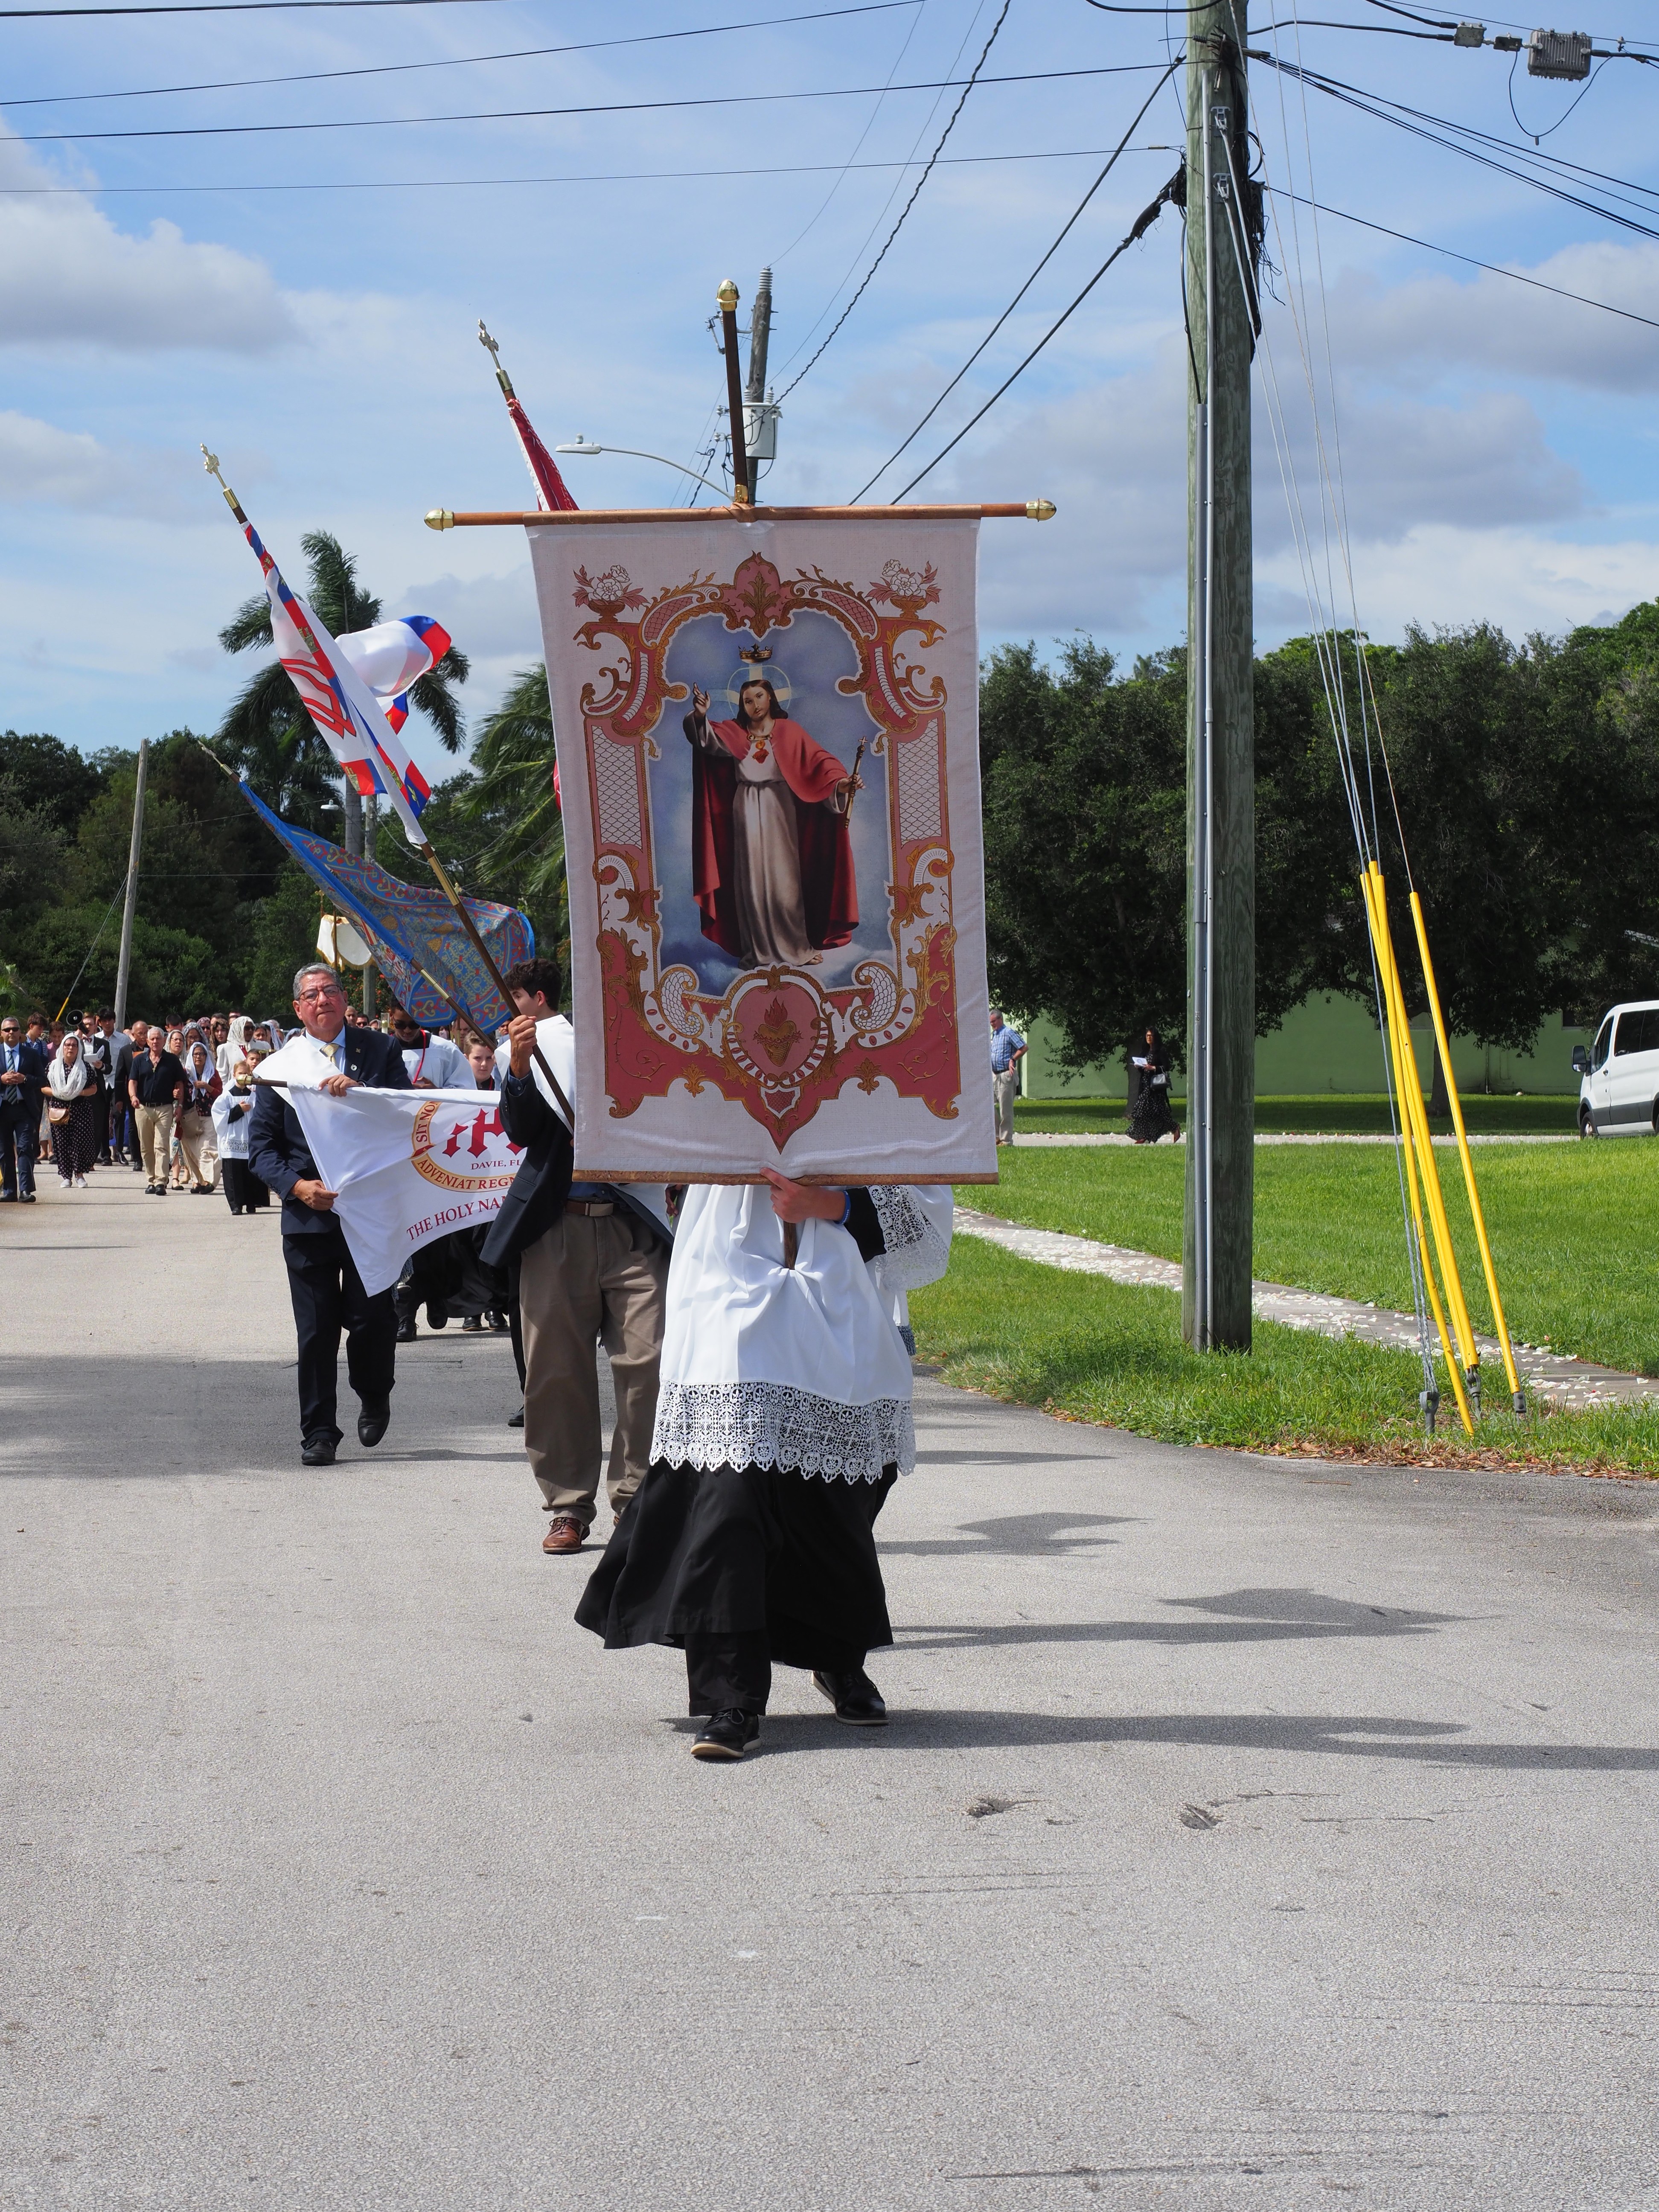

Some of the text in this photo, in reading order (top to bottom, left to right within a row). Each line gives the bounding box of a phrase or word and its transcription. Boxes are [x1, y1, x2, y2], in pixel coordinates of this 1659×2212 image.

[416, 1123, 428, 1143] SIT
[417, 1159, 475, 1190] ADVENIAT
[471, 1160, 506, 1170] DAVIE,
[406, 1217, 433, 1241] THE
[434, 1202, 474, 1227] HOLY
